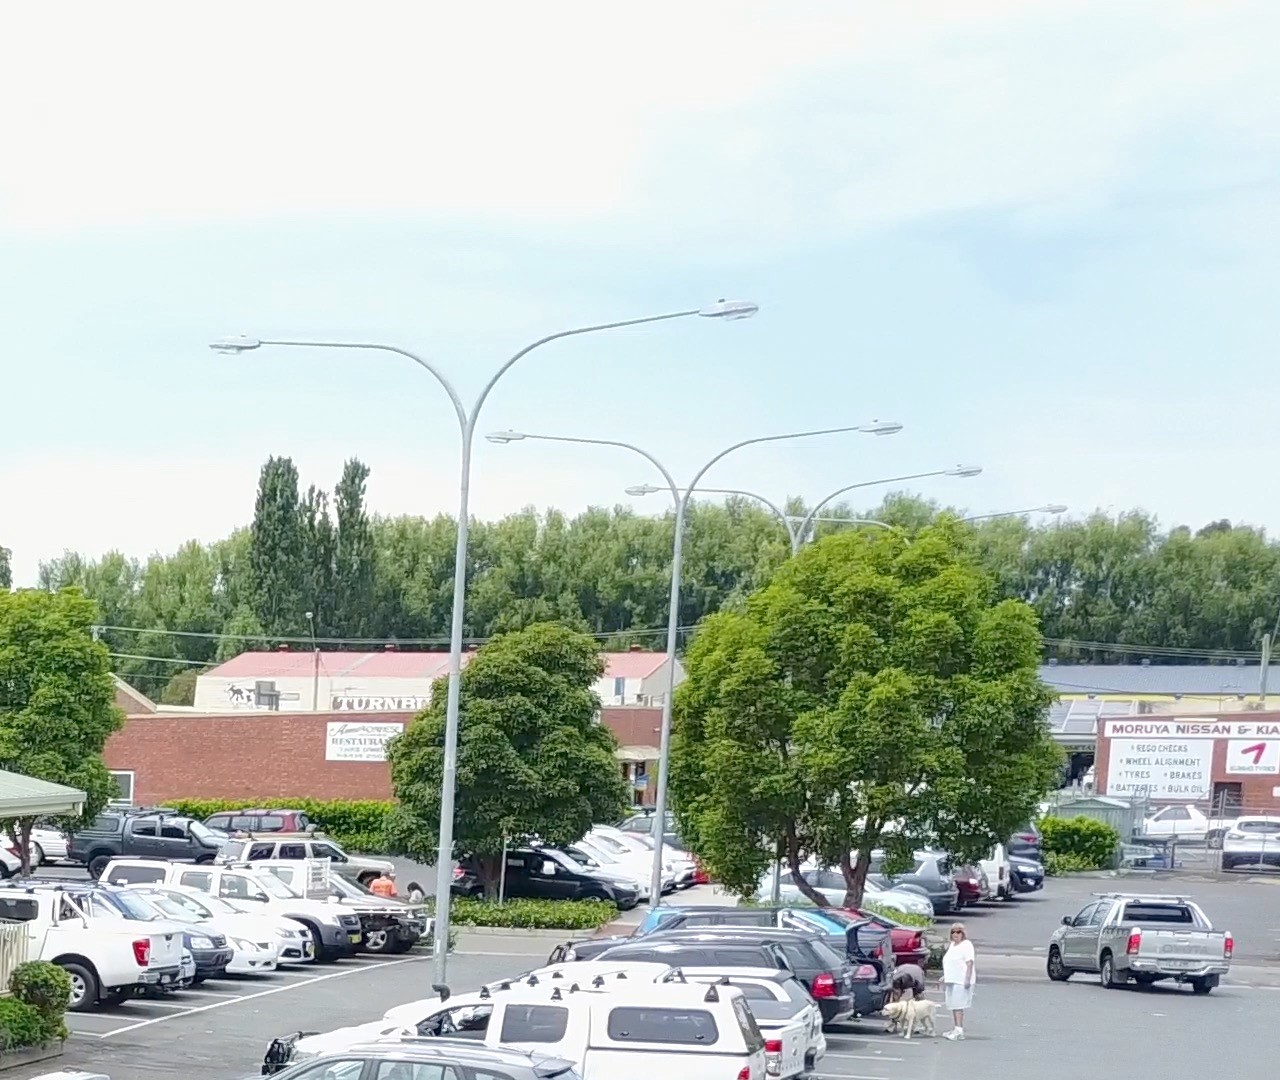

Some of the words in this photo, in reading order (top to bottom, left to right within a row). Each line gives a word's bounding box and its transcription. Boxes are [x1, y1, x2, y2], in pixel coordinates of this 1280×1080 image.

[1112, 724, 1170, 734] MORUYA
[1176, 725, 1231, 734] NISSAN
[1237, 725, 1252, 735] &
[1158, 744, 1188, 753] CHECKS
[1125, 757, 1152, 766] WHEEL
[1154, 758, 1201, 767] ALIGNMENT
[1124, 770, 1151, 779] TYRES
[1169, 771, 1203, 780] BRAKES
[1115, 783, 1158, 792] BATTERIES
[1167, 784, 1189, 793] BULK
[1190, 785, 1204, 794] OIL
